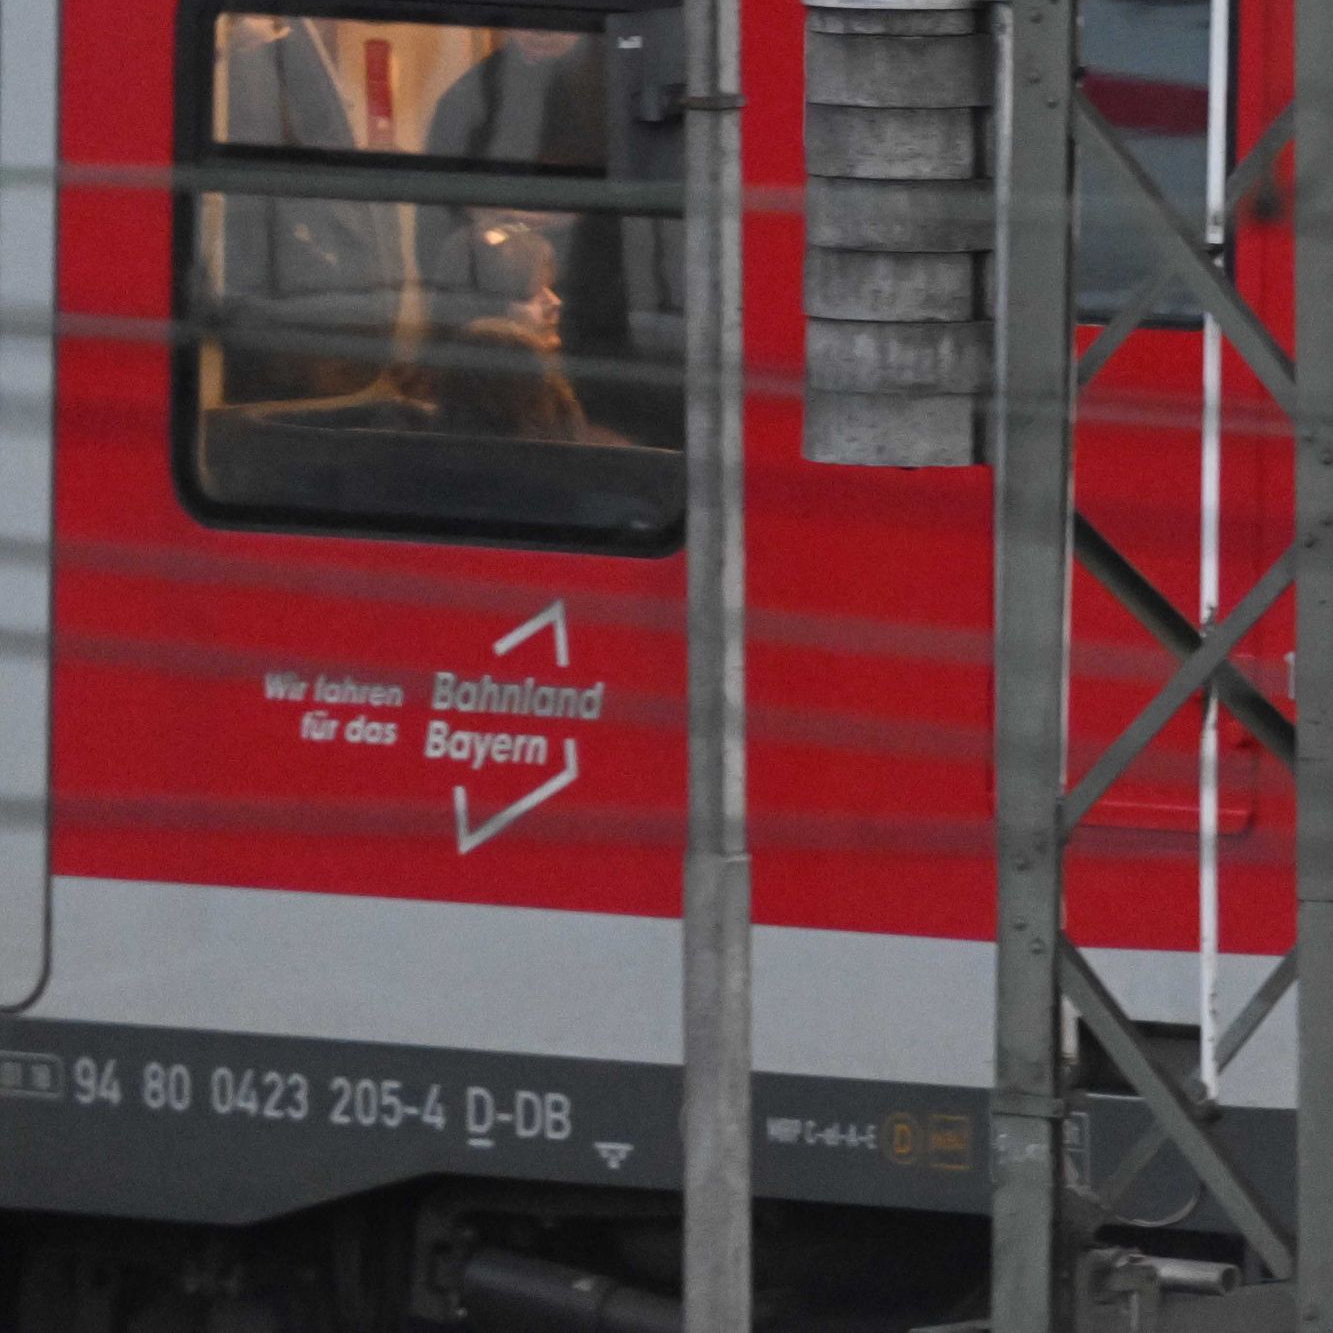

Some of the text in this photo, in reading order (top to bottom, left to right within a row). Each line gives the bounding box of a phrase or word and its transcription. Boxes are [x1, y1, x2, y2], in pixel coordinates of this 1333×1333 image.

[431, 672, 605, 719] Bahnland
[343, 715, 398, 745] das
[424, 720, 548, 770] Bayern
[73, 1055, 122, 1105] 94
[143, 1061, 192, 1111] 80
[210, 1066, 309, 1120] 0423
[330, 1076, 446, 1131] 205-4
[465, 1085, 571, 1141] D-DB
